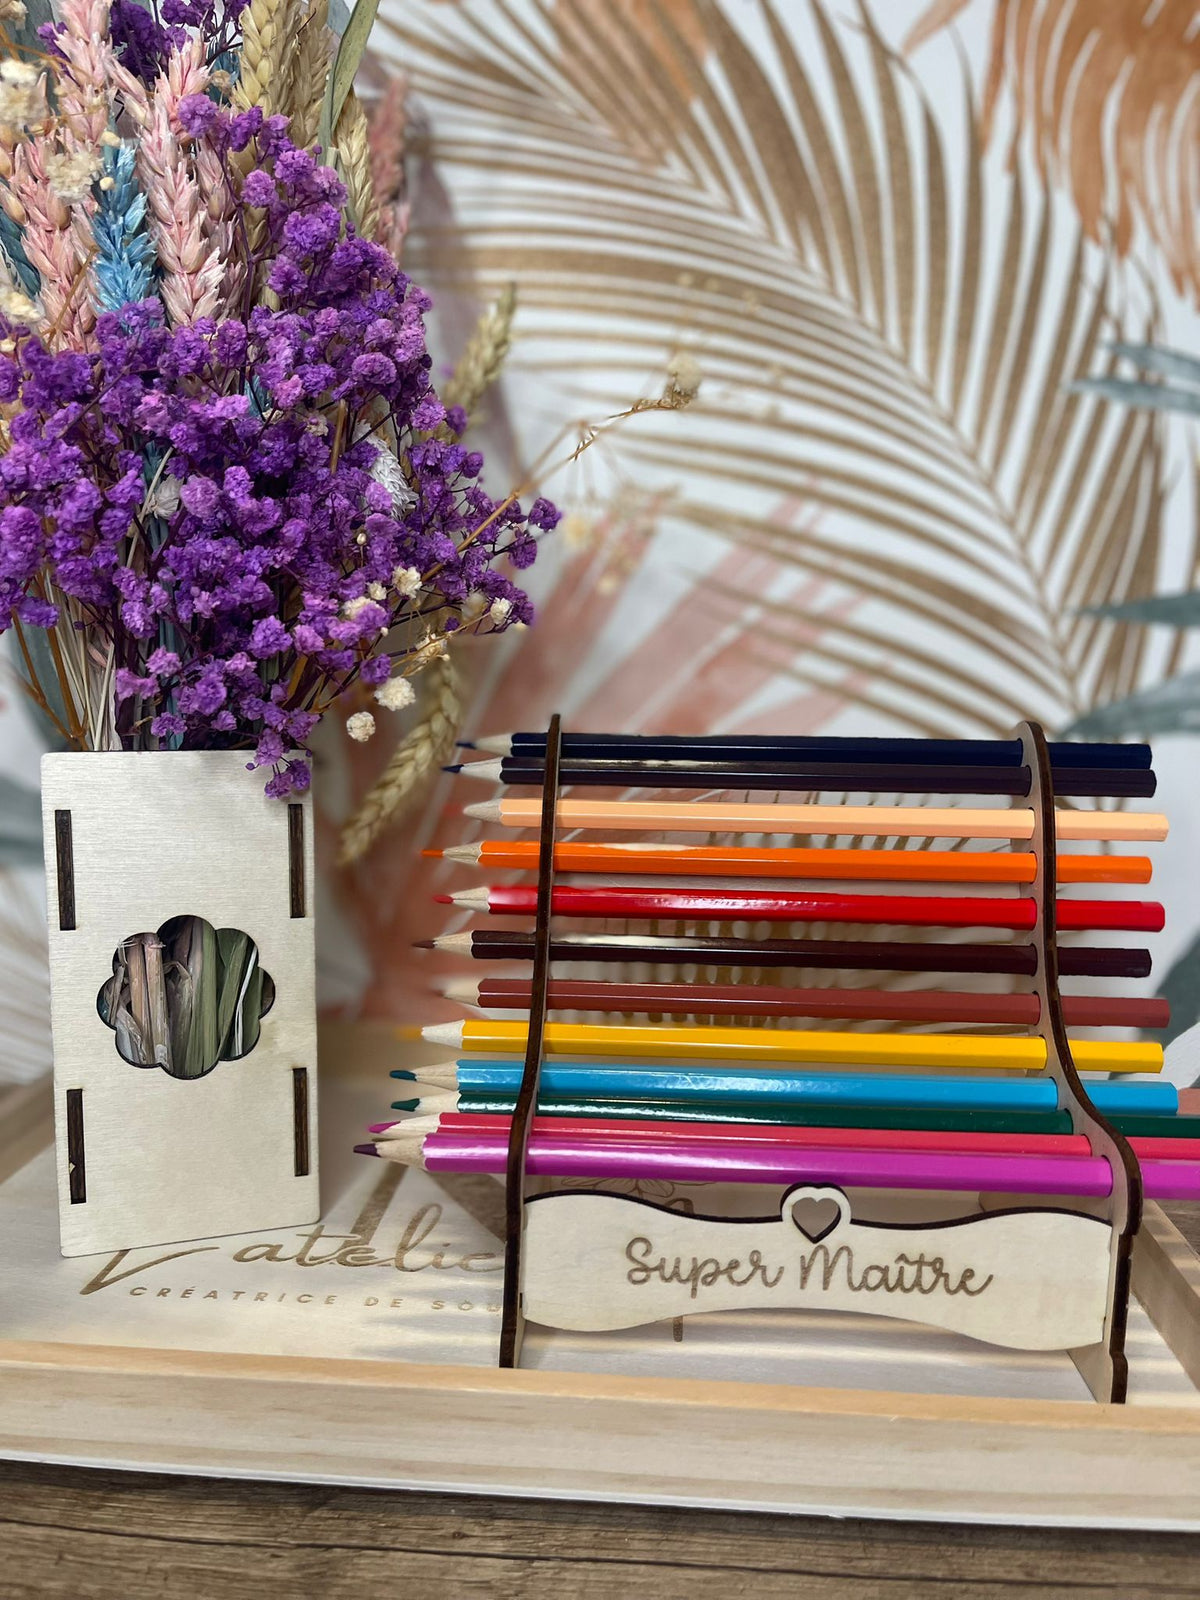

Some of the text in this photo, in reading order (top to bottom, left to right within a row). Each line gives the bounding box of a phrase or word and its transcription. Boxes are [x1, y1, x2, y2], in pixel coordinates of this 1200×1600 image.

[625, 1237, 993, 1299] Super Maître
[129, 1286, 337, 1306] CRÉATRICE
[363, 1296, 404, 1309] DE
